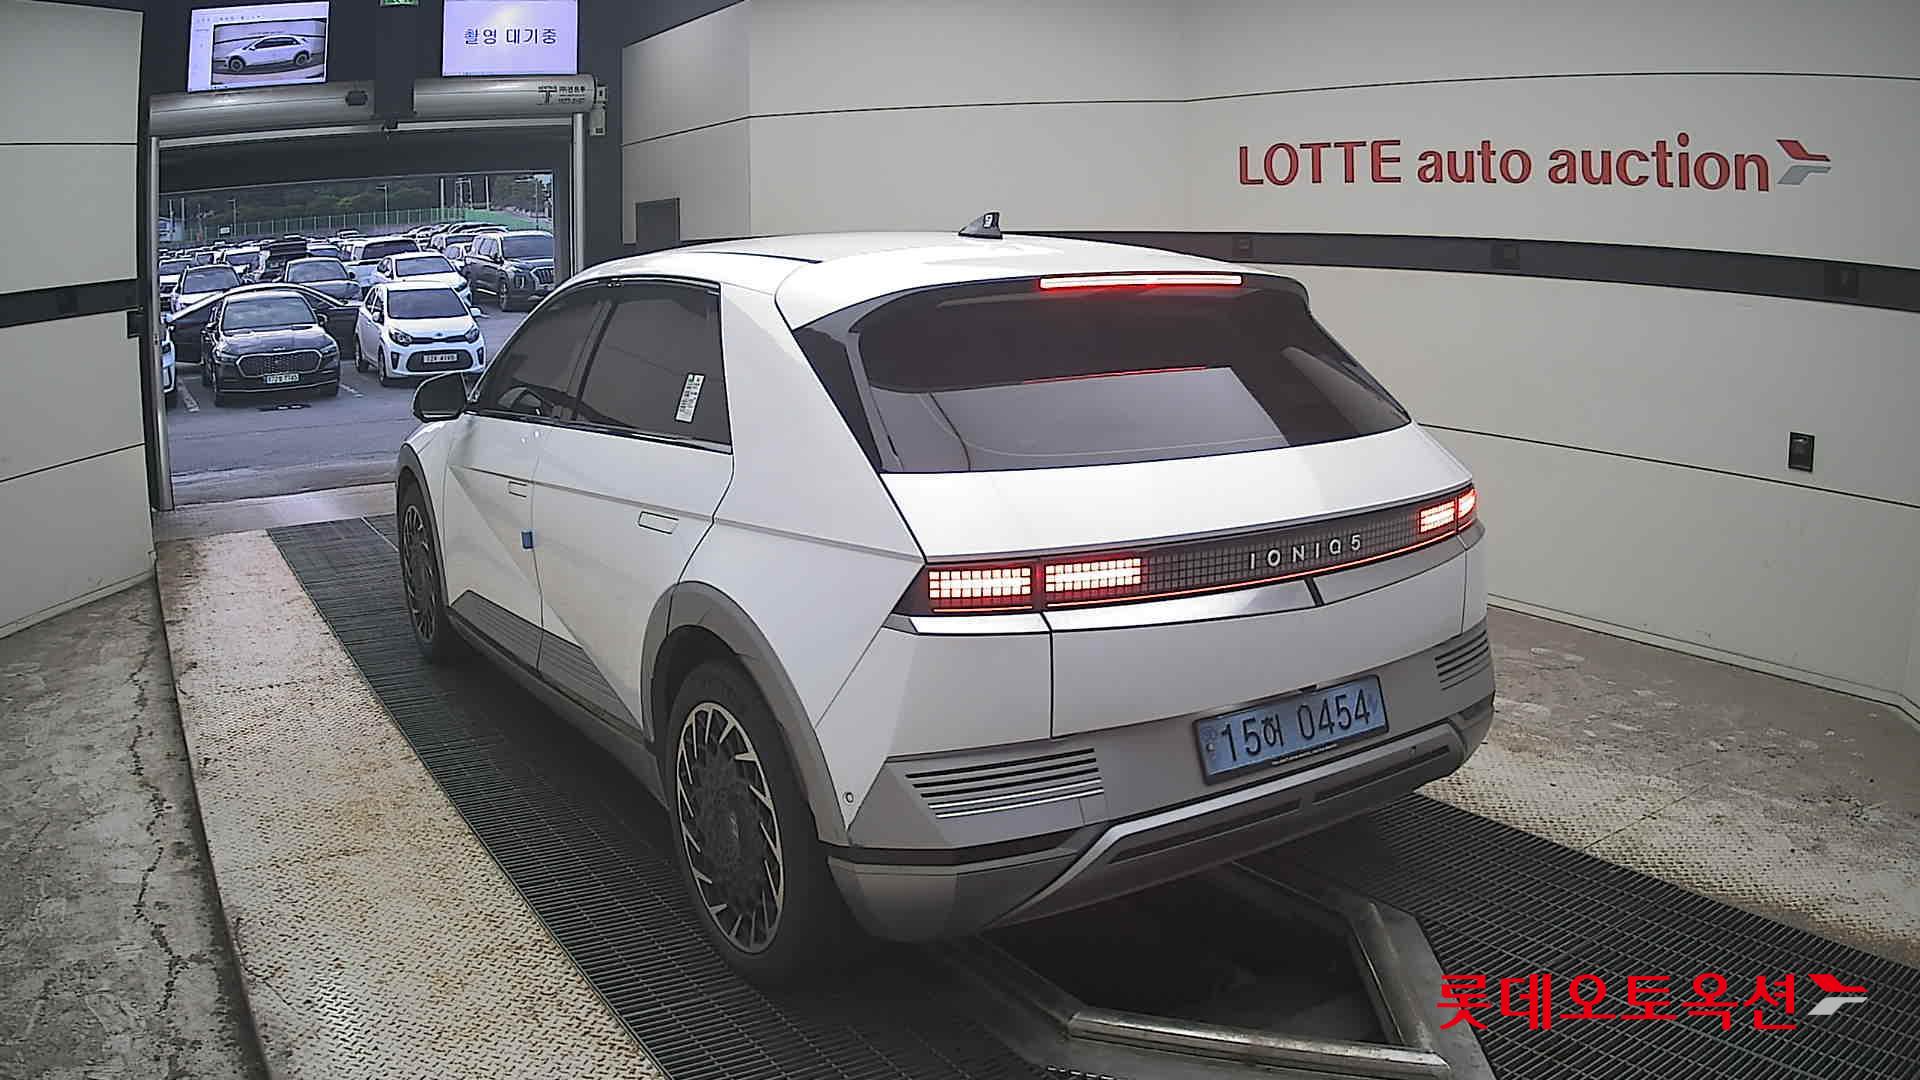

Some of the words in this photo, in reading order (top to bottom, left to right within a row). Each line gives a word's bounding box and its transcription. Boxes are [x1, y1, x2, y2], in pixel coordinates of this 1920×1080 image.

[506, 28, 557, 45] 대기중
[1238, 138, 1401, 186] LOTTE
[1417, 139, 1532, 185] auto
[1548, 132, 1770, 192] auction
[1221, 713, 1285, 762] 15허
[1296, 688, 1371, 741] 0454
